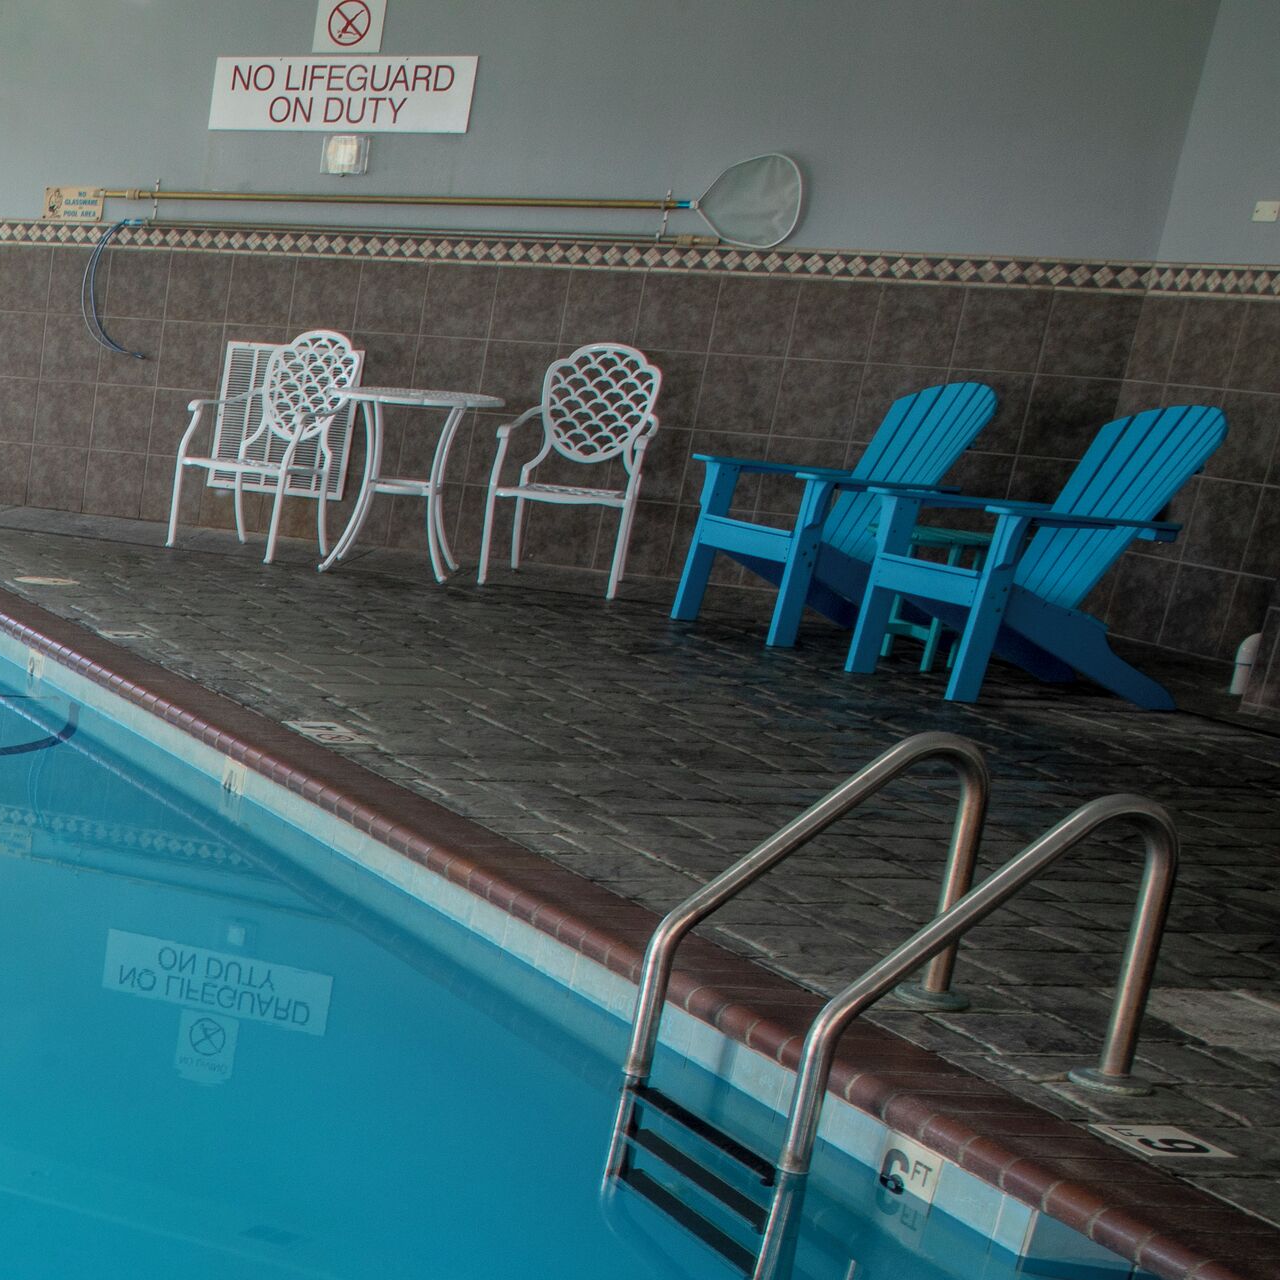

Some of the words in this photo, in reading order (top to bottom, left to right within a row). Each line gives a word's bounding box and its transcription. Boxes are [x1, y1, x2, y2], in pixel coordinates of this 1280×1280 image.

[231, 64, 275, 91] NO
[285, 64, 455, 93] LIFEGUARD
[269, 96, 314, 123] ON
[323, 97, 408, 124] DUTY
[911, 1160, 933, 1188] FT
